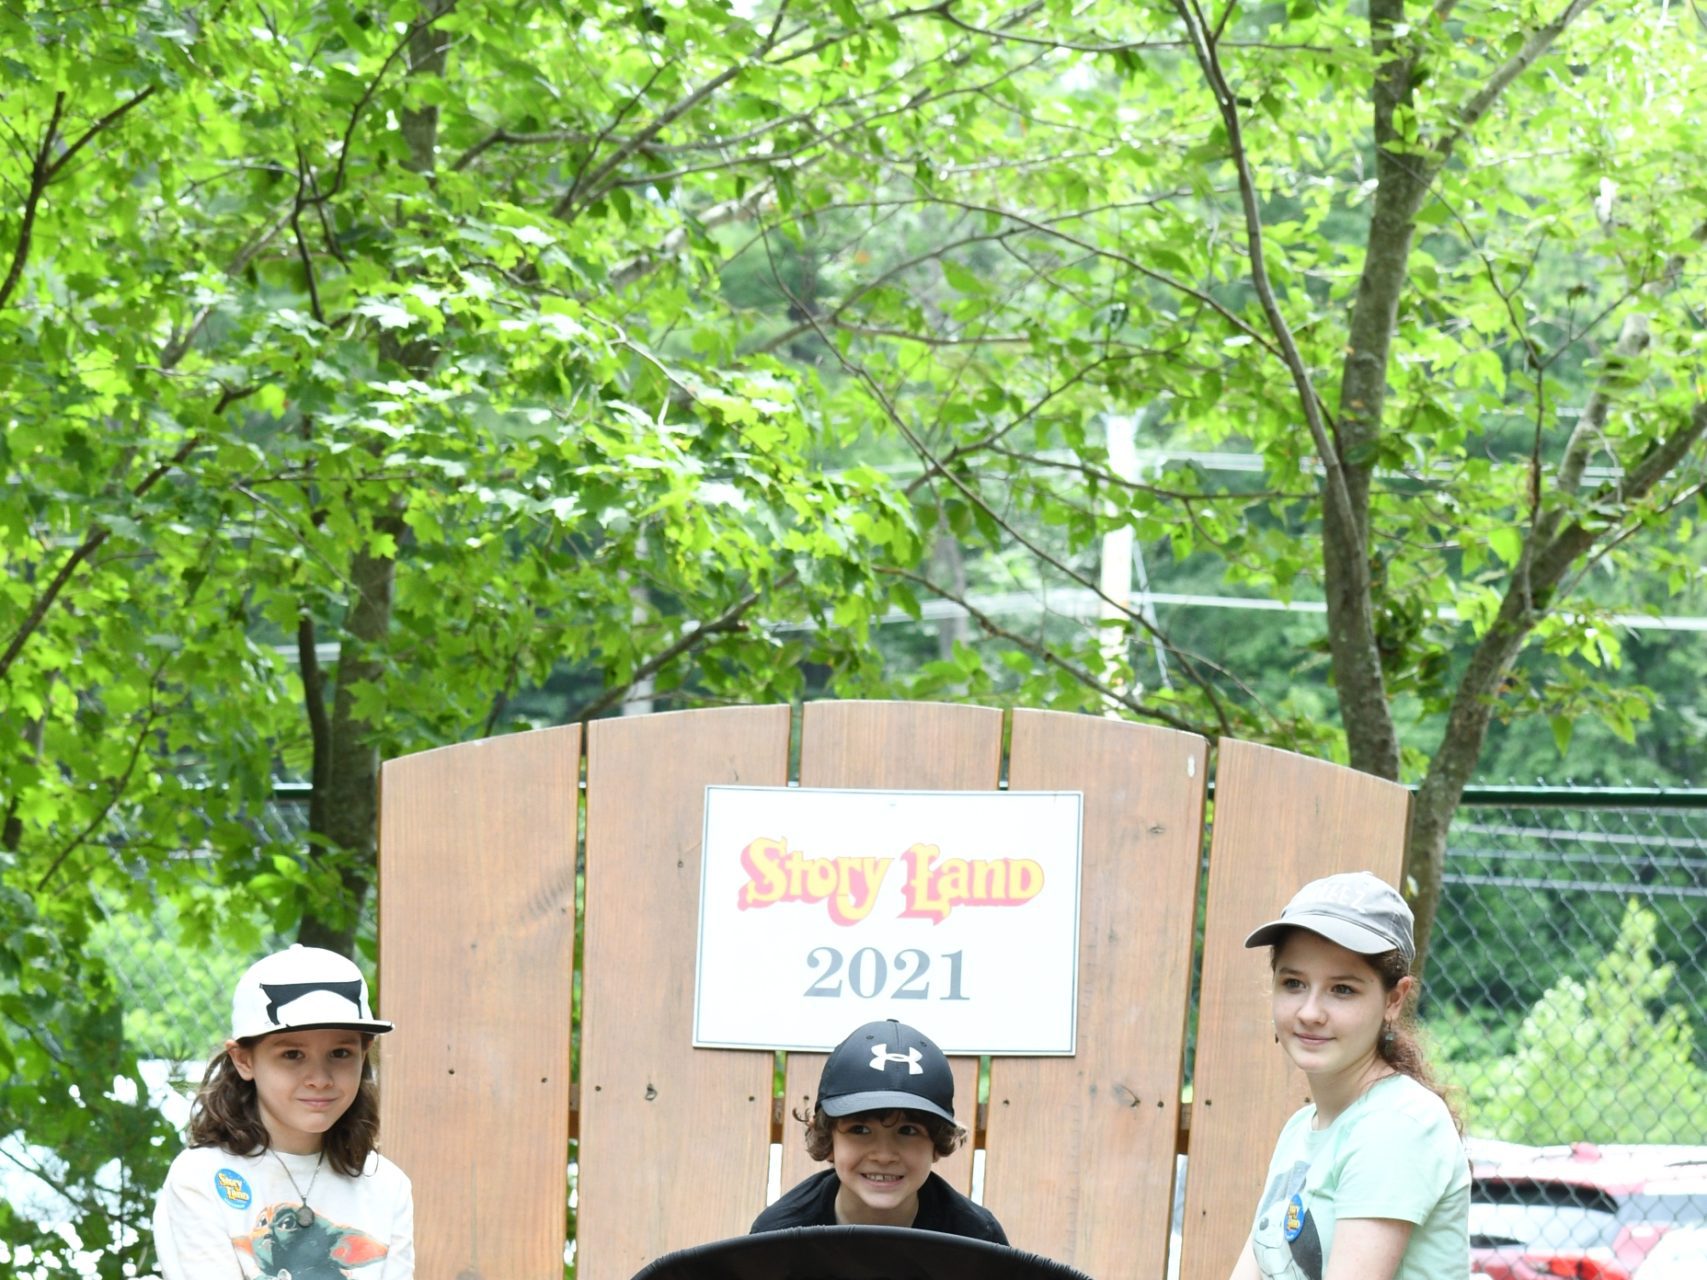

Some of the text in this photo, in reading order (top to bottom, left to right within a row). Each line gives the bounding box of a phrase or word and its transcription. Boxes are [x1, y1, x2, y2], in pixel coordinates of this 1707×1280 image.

[737, 836, 1045, 927] Story Land
[803, 946, 970, 1001] 2021
